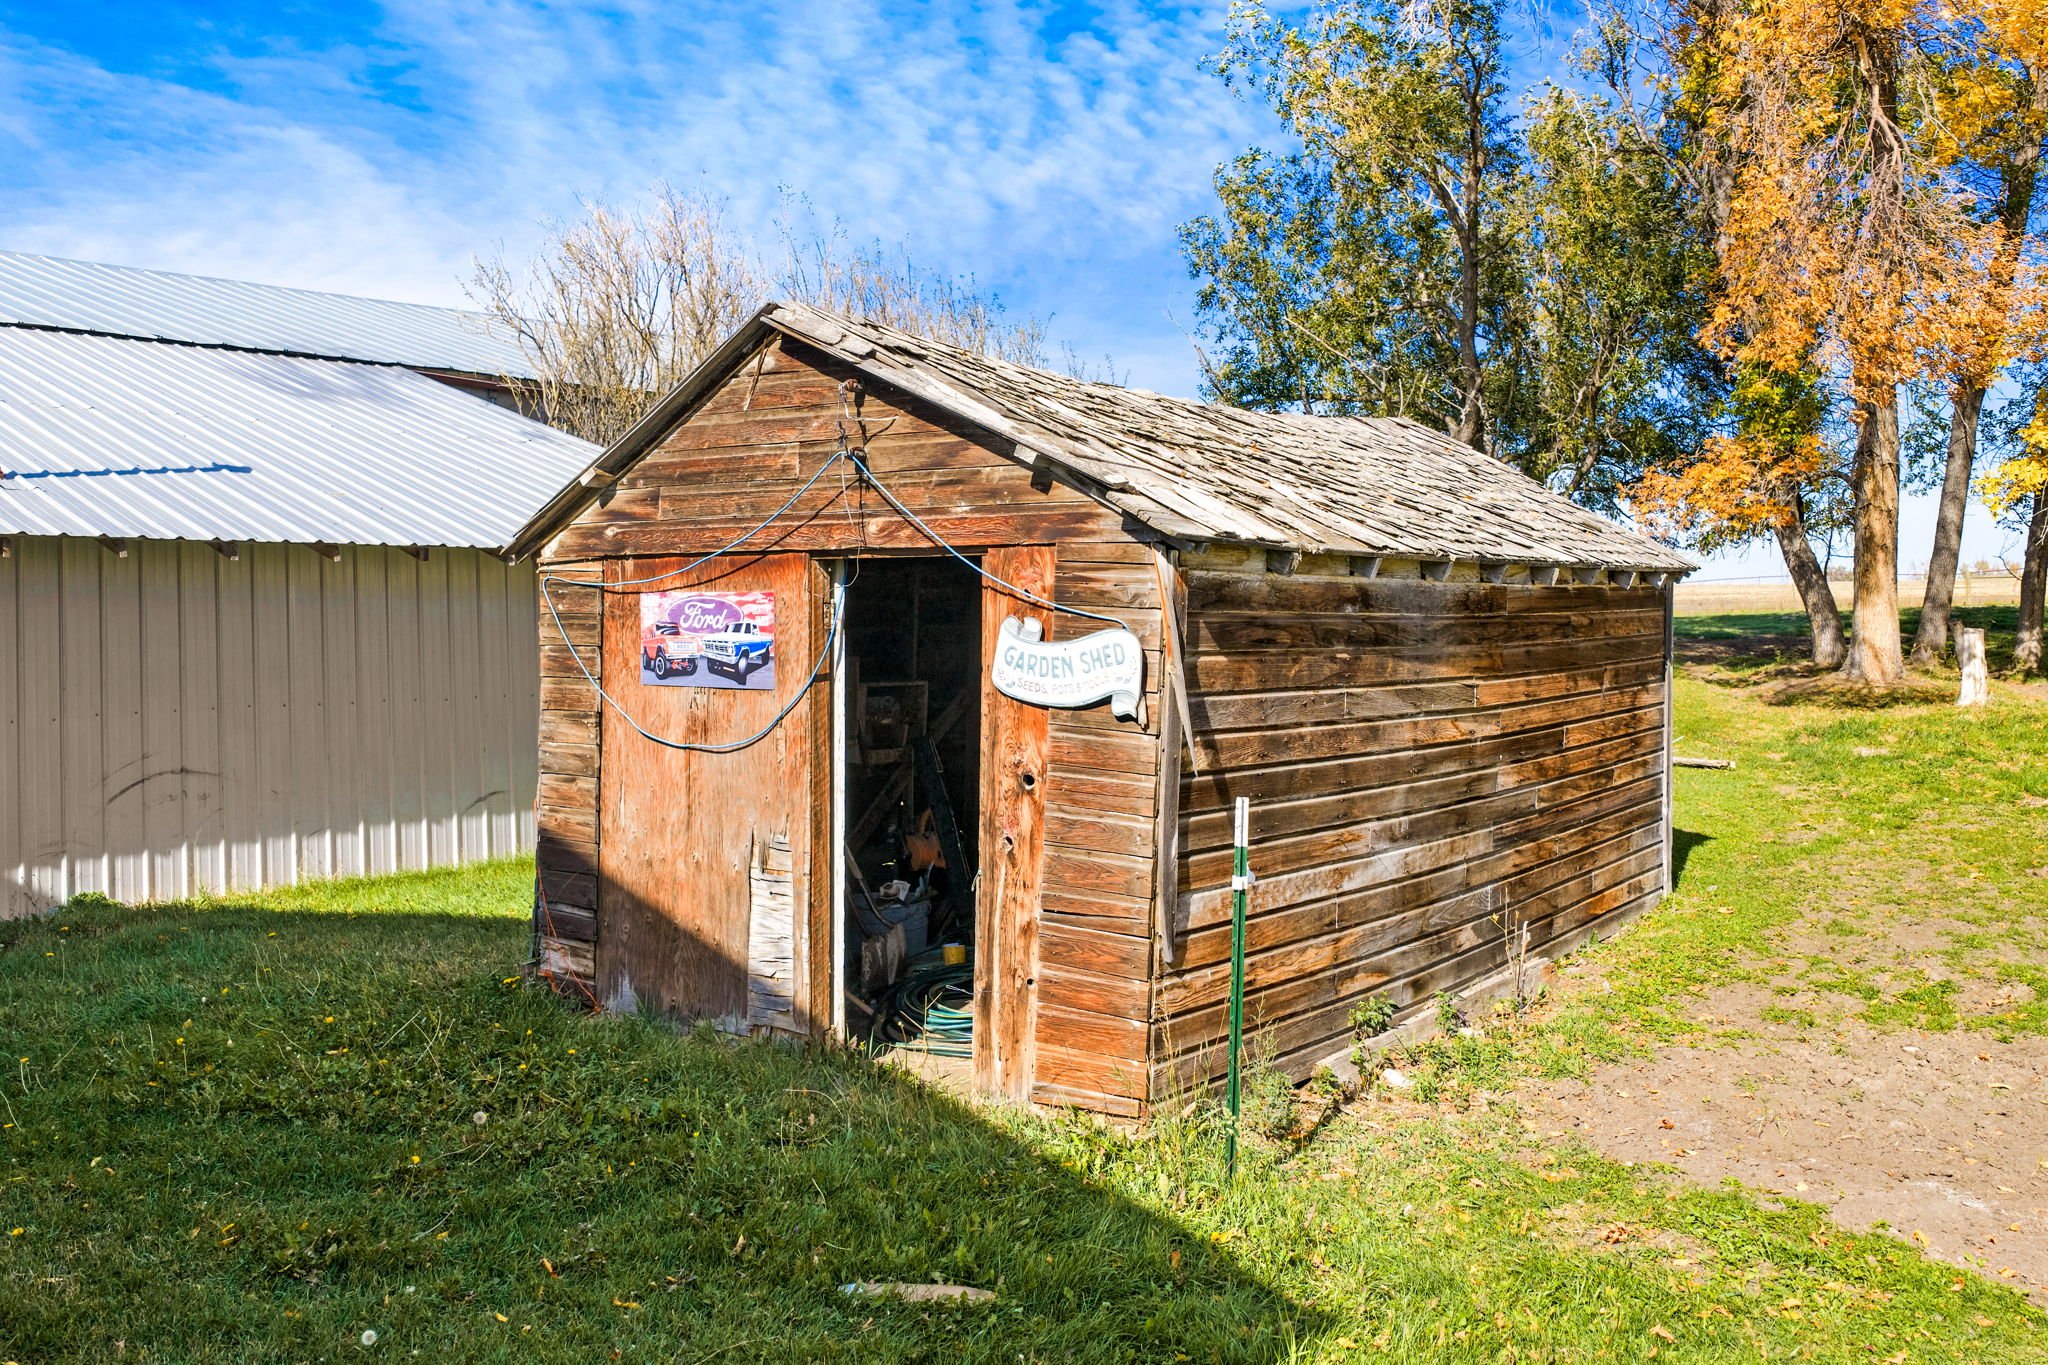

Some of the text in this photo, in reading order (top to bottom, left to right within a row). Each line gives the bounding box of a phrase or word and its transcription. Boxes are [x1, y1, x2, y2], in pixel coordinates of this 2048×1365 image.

[680, 601, 729, 629] Ford
[1004, 642, 1126, 679] GARDEN SHED
[1051, 683, 1075, 695] POTS
